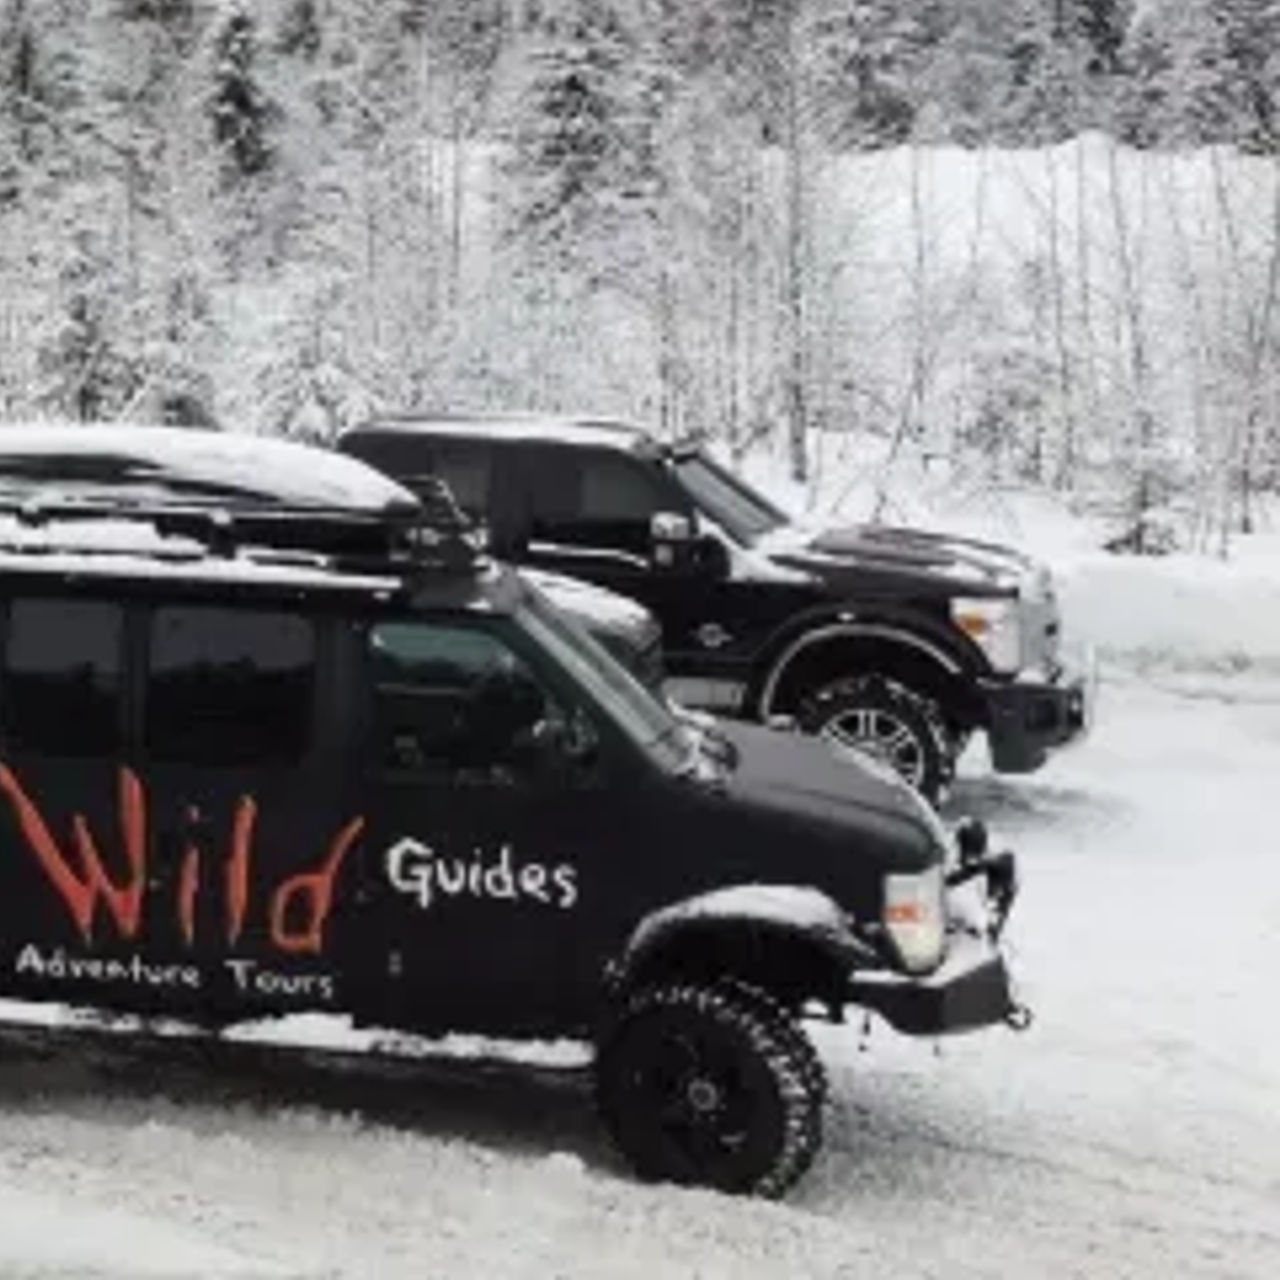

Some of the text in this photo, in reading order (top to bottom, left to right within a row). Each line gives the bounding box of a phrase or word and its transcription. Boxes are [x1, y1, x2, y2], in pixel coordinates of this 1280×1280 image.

[385, 835, 579, 909] Guides
[15, 942, 334, 999] Adventure Tours
